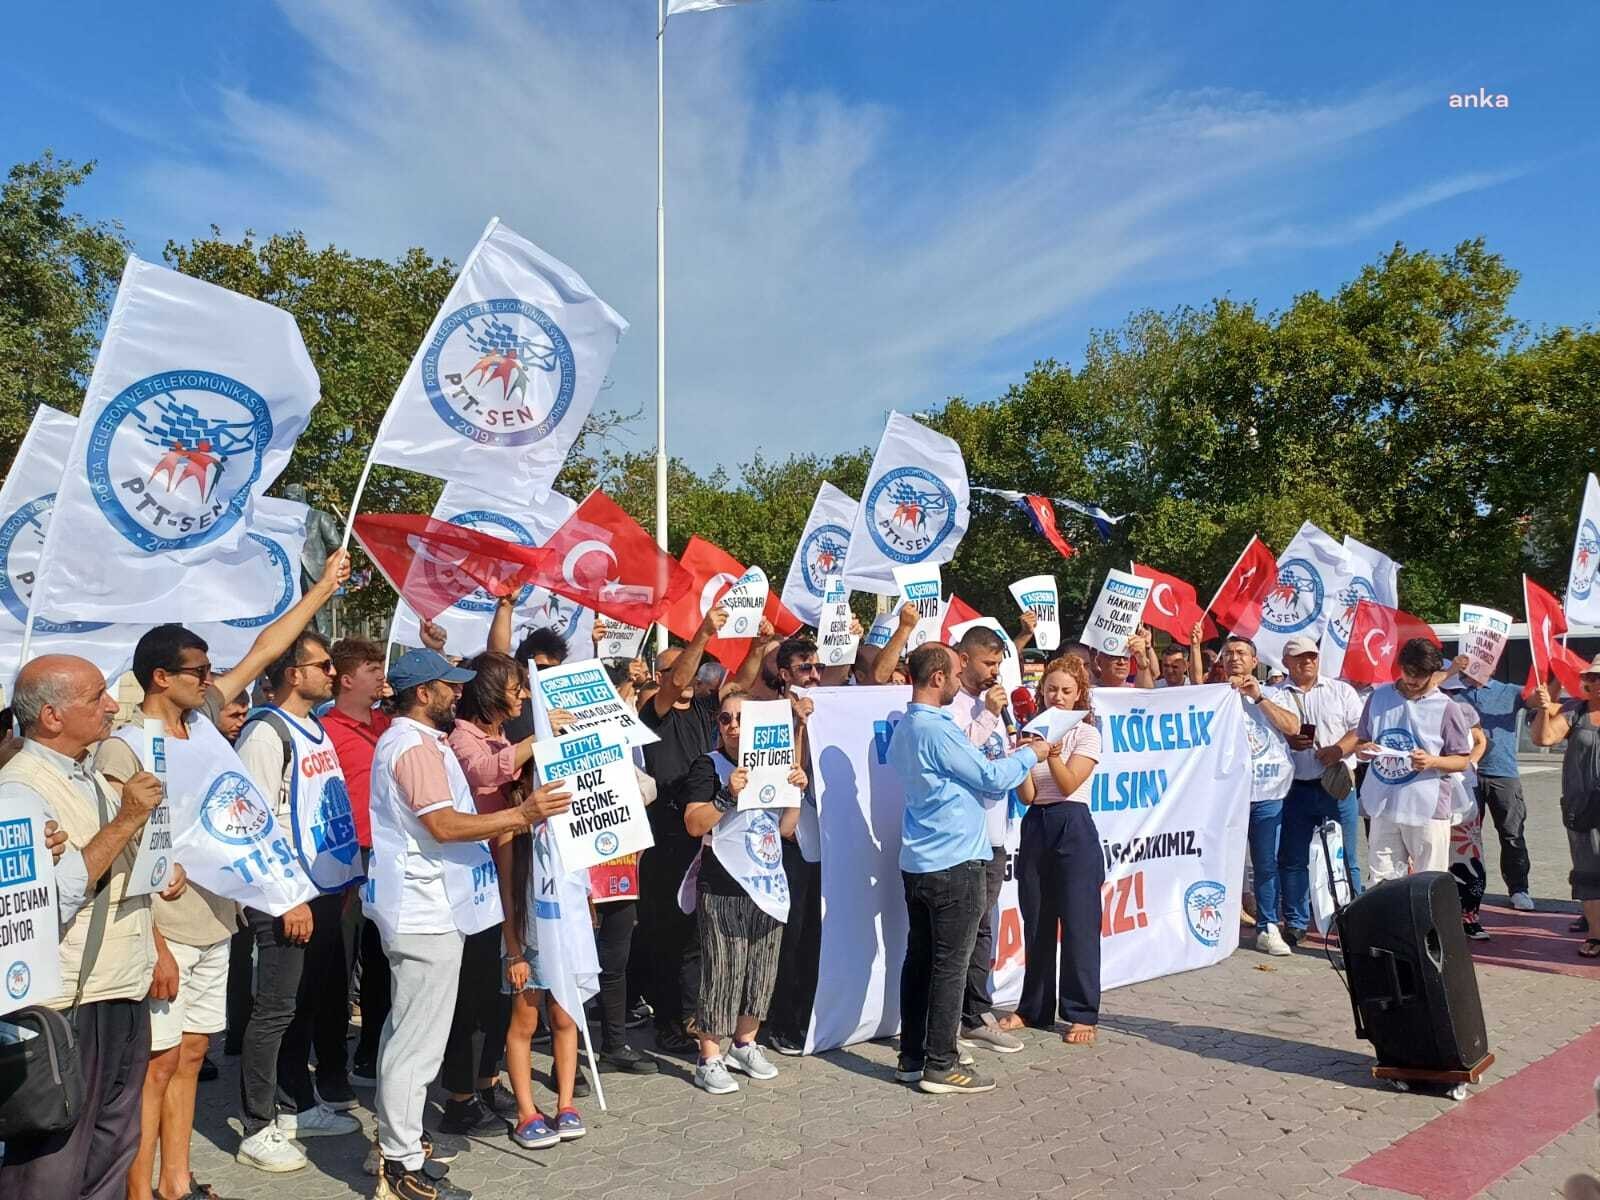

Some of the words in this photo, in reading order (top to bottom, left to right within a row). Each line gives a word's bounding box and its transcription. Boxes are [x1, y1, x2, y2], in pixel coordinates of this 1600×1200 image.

[444, 373, 534, 427] PTT-SEN
[94, 402, 128, 454] TELEFON
[127, 388, 146, 404] VE
[455, 421, 489, 442] 2019
[121, 477, 223, 532] PTT-SEN
[880, 520, 931, 551] PTT-SEN
[755, 727, 776, 748] EŞİT
[777, 726, 789, 747] İŞE
[1110, 705, 1215, 752] KÖLELİK
[743, 749, 766, 772] EŞİT
[576, 769, 605, 792] AÇIZ
[571, 789, 619, 816] GEÇİNE-
[569, 805, 631, 838] MİYORUZ!
[12, 887, 50, 914] DEVAM
